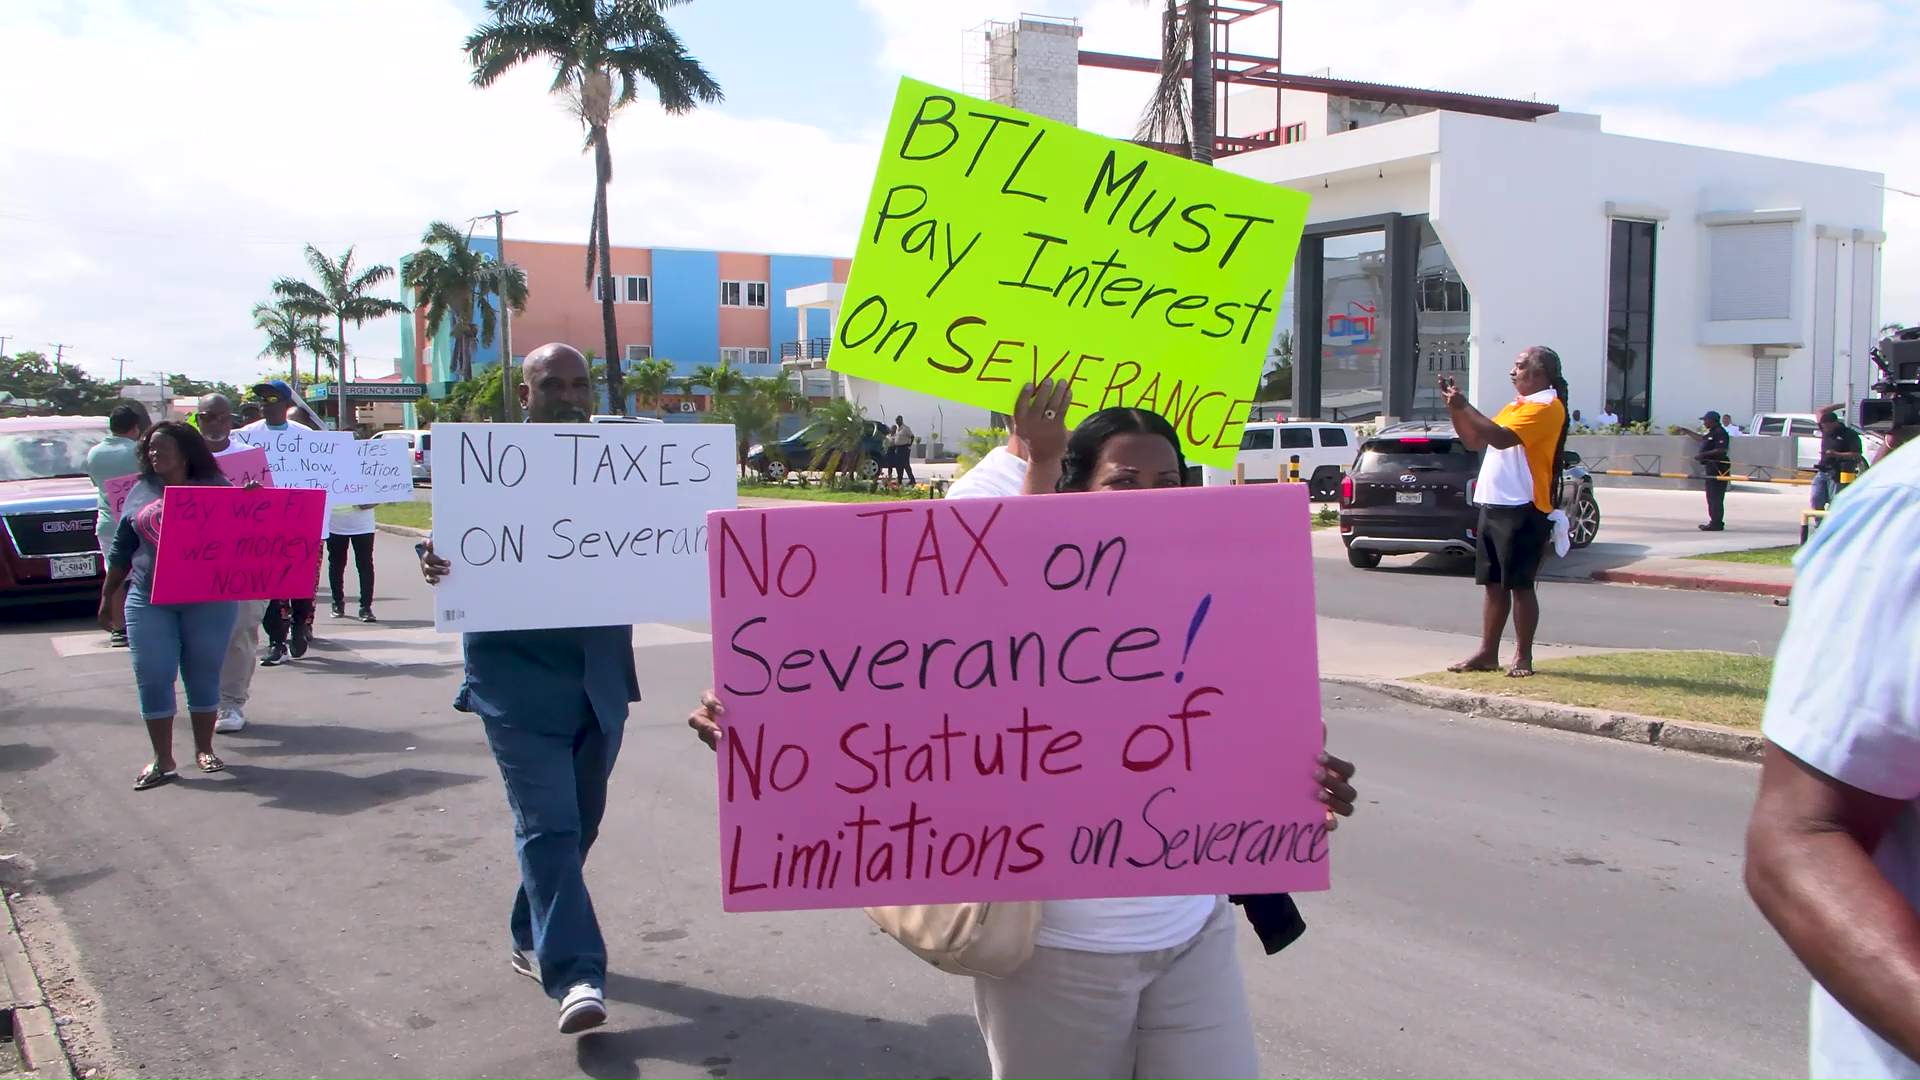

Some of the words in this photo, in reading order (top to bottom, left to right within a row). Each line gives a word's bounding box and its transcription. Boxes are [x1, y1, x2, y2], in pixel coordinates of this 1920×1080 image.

[899, 95, 1048, 203] BTL
[873, 185, 982, 298] Pay
[998, 231, 1273, 344] Interest
[330, 386, 388, 395] EERGENCY
[390, 386, 400, 394] 24
[401, 386, 421, 394] HRS
[840, 294, 918, 362] On
[927, 316, 1255, 449] SEVERANCE
[276, 432, 303, 453] Got
[309, 440, 339, 455] our
[460, 431, 527, 487] NO
[554, 433, 712, 486] TAXES
[43, 519, 94, 533] GMC
[173, 491, 217, 528] Pay
[232, 502, 271, 522] we
[460, 524, 525, 566] ON
[183, 539, 220, 561] we
[719, 515, 817, 598] No
[856, 503, 1009, 597] TAX
[1044, 536, 1127, 597] on
[723, 594, 1213, 697] Severance!
[727, 722, 810, 802] No
[835, 707, 1084, 795] Statute
[1122, 686, 1224, 771] of
[729, 801, 1046, 896] Limitations
[1070, 816, 1122, 870] on
[1126, 787, 1330, 871] Severance
